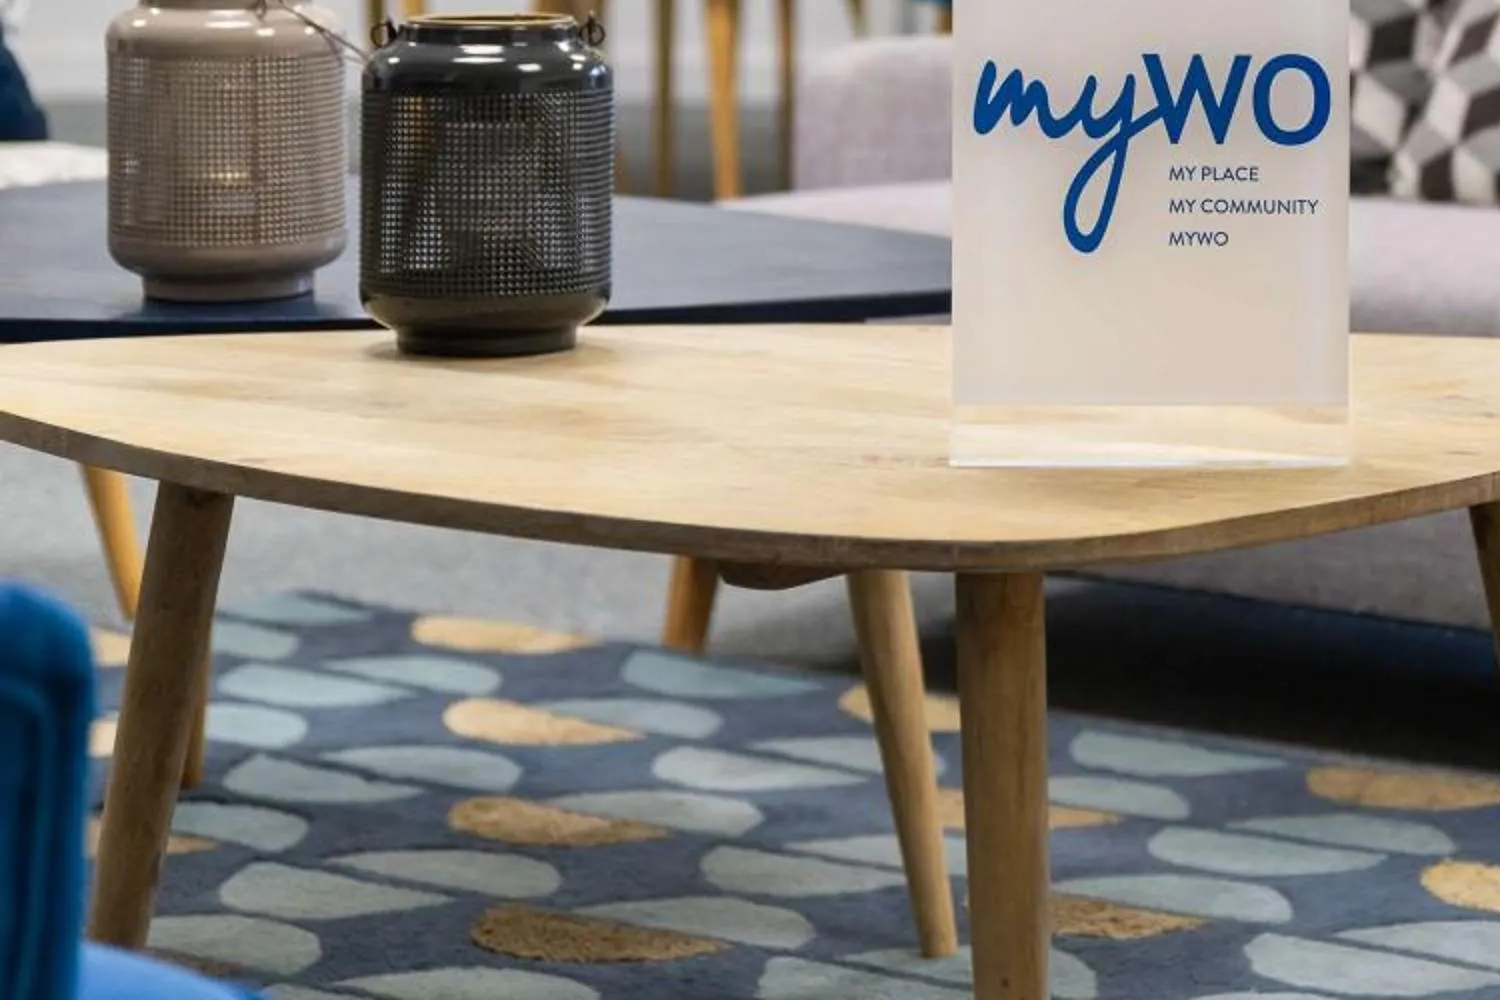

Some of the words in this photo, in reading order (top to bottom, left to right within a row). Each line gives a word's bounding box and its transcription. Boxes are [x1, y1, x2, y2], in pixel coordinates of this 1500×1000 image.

[973, 53, 1331, 253] myWO
[1168, 166, 1197, 182] MY
[1201, 166, 1259, 182] PLACE
[1168, 199, 1197, 214] MY
[1201, 199, 1319, 214] COMMUNITY
[1168, 231, 1229, 247] MYWO
